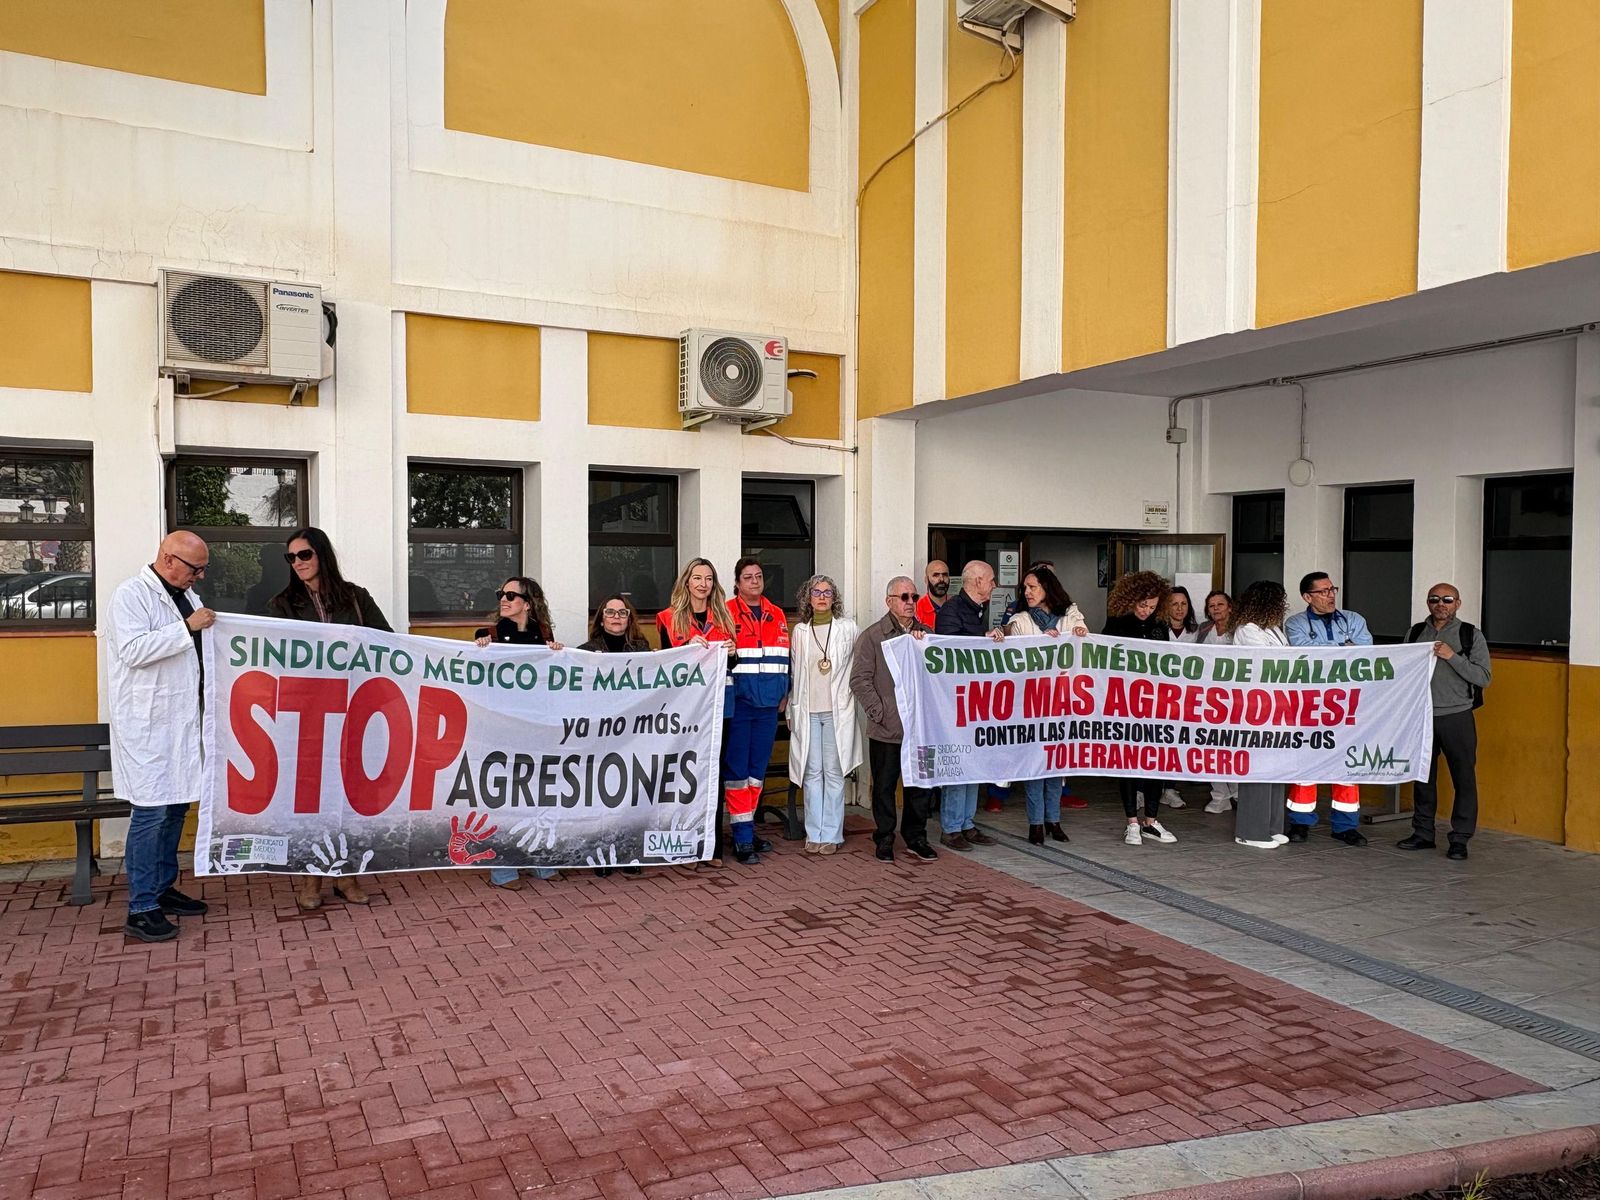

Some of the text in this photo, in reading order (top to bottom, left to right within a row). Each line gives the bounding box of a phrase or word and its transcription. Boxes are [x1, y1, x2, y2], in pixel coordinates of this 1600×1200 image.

[272, 287, 315, 299] Panasonic
[229, 635, 706, 692] SINDICATO MÉDICO DE MÁLAGA
[924, 643, 1394, 684] SINDICATO MÉDICO DE MÁLAGA
[956, 670, 1360, 728] ¡NO MÁS AGRESIONES!
[226, 669, 468, 818] STOP
[559, 702, 699, 745] ya no más...
[974, 720, 1336, 750] CONTRA LAS AGRESIONES A SANITARIAS-OS
[937, 744, 972, 754] SINDICATO
[1044, 742, 1250, 776] TOLERANCIA CERO
[446, 750, 698, 809] AGRESIONES
